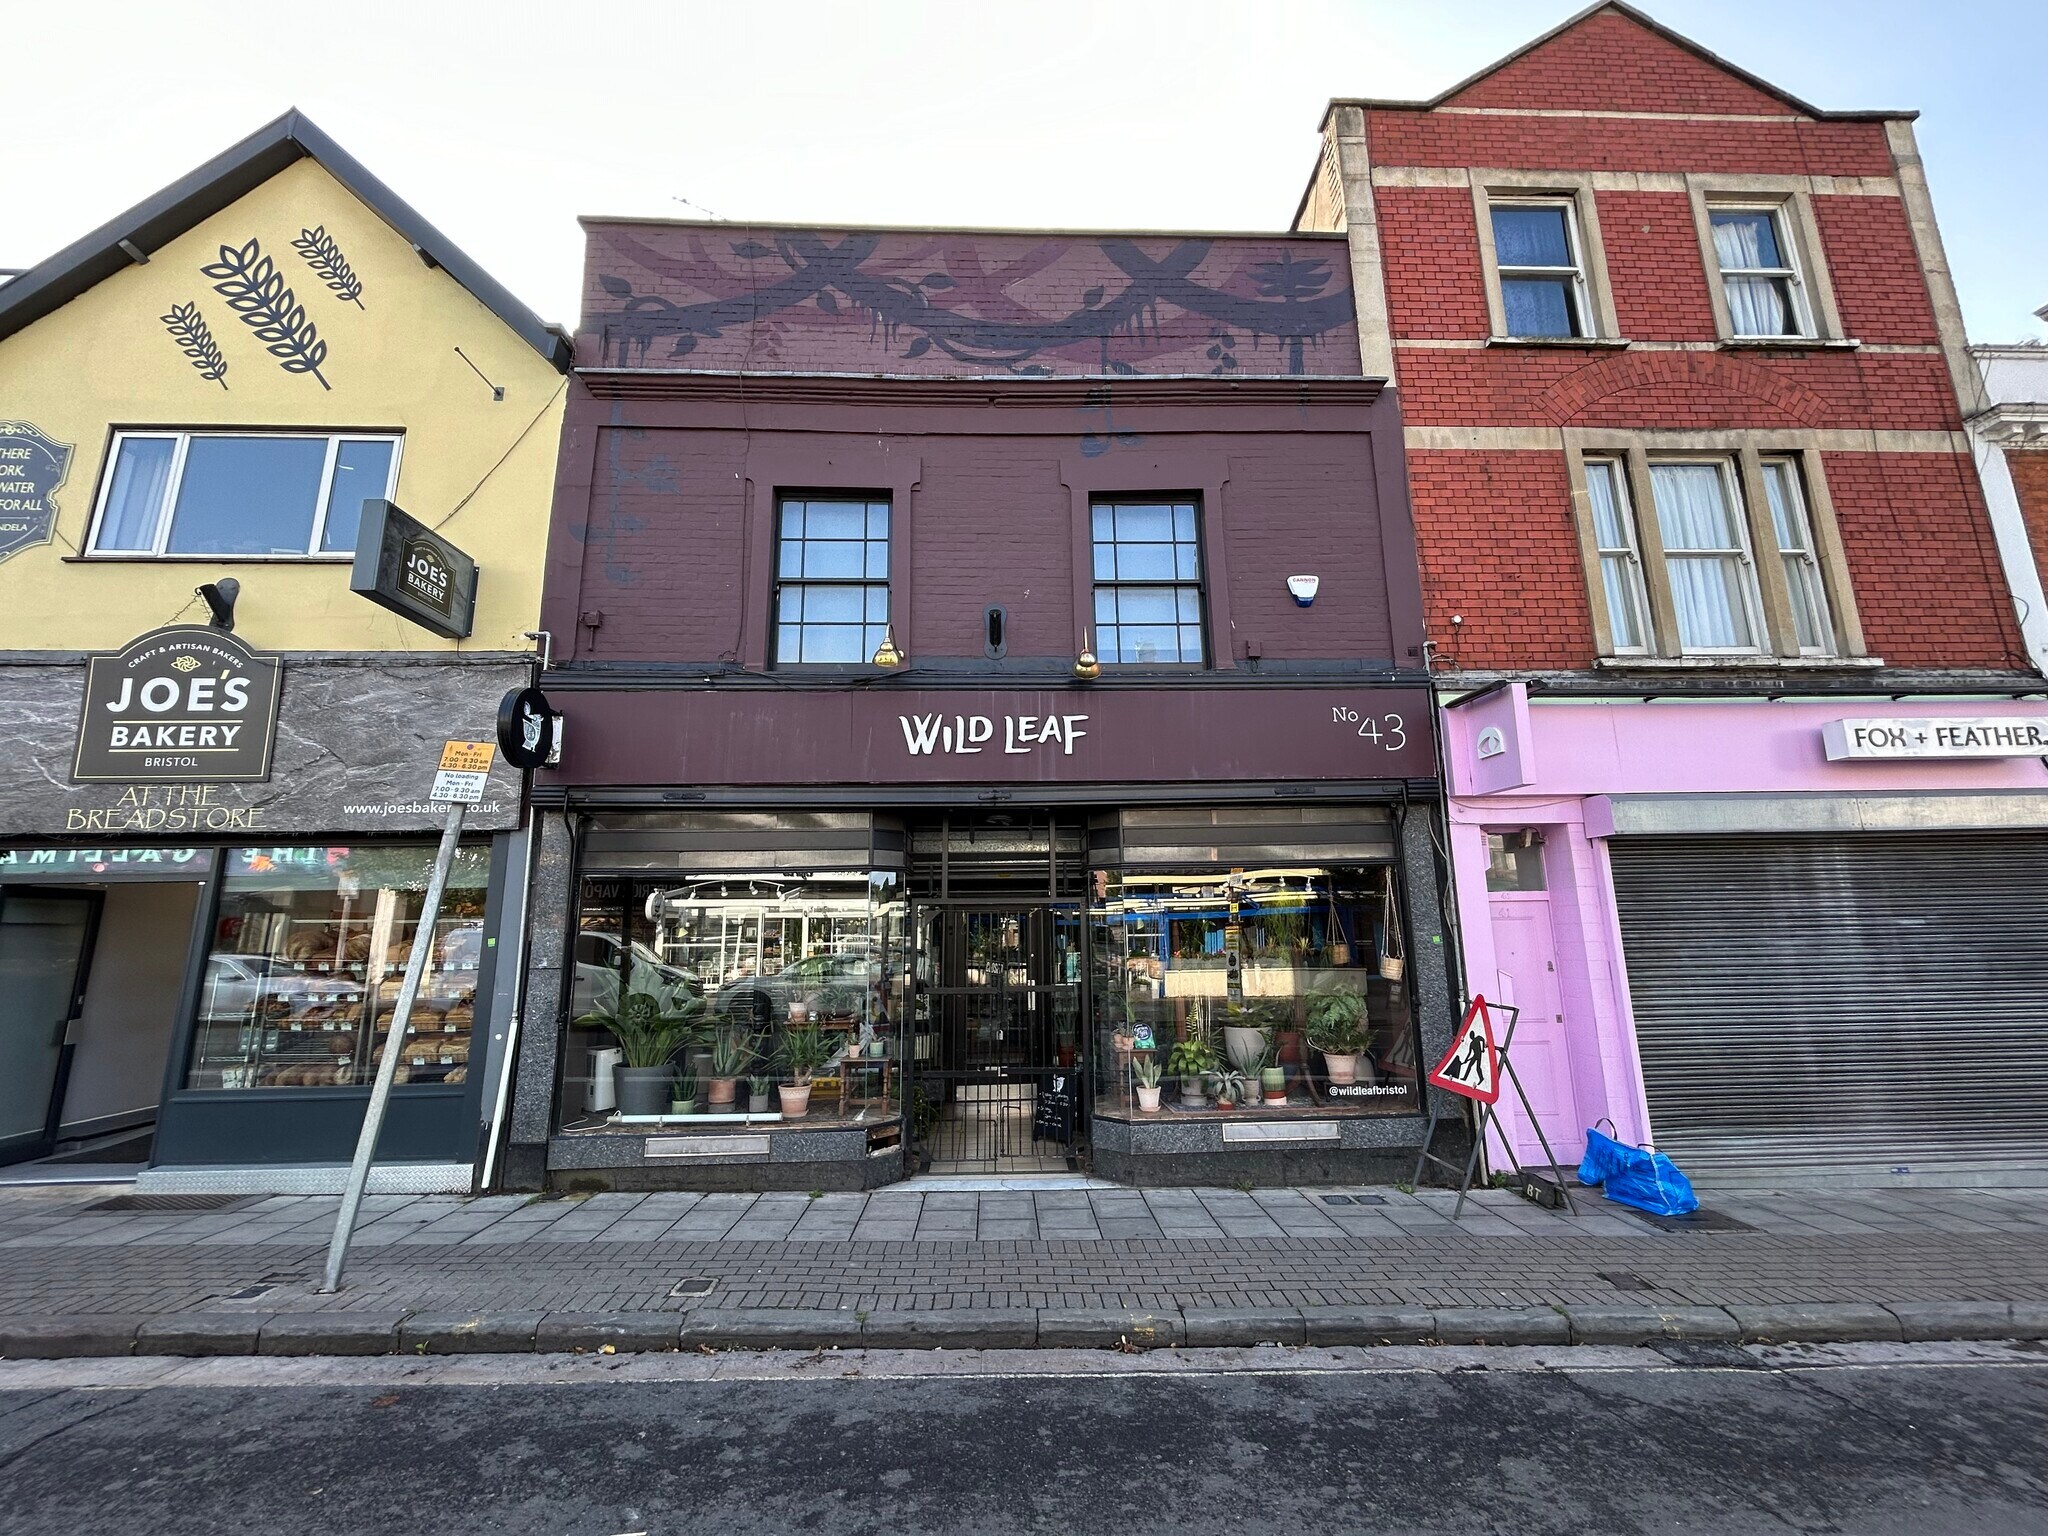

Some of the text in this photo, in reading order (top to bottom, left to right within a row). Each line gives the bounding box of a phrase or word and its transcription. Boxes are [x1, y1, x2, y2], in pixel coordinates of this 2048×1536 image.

[21, 499, 42, 510] ALL
[407, 553, 448, 587] JOE'S
[408, 573, 445, 600] BAKERY
[128, 649, 156, 668] CRAFT
[169, 643, 210, 652] ARTISAN
[212, 647, 243, 669] BAKERS
[105, 669, 251, 712] JOE'S
[110, 725, 242, 747] BAKERY
[898, 712, 1090, 755] WILD LEAF
[1332, 706, 1406, 751] No 43
[1854, 726, 2043, 747] FOX + FEATHER
[144, 756, 199, 767] BRISTOL
[116, 785, 220, 806] AT THE
[66, 807, 267, 830] BREADSTORE
[343, 800, 500, 816] www.joesbakerco.uk
[1329, 1085, 1408, 1097] @wildleafbristol
[1527, 1183, 1542, 1200] BT
